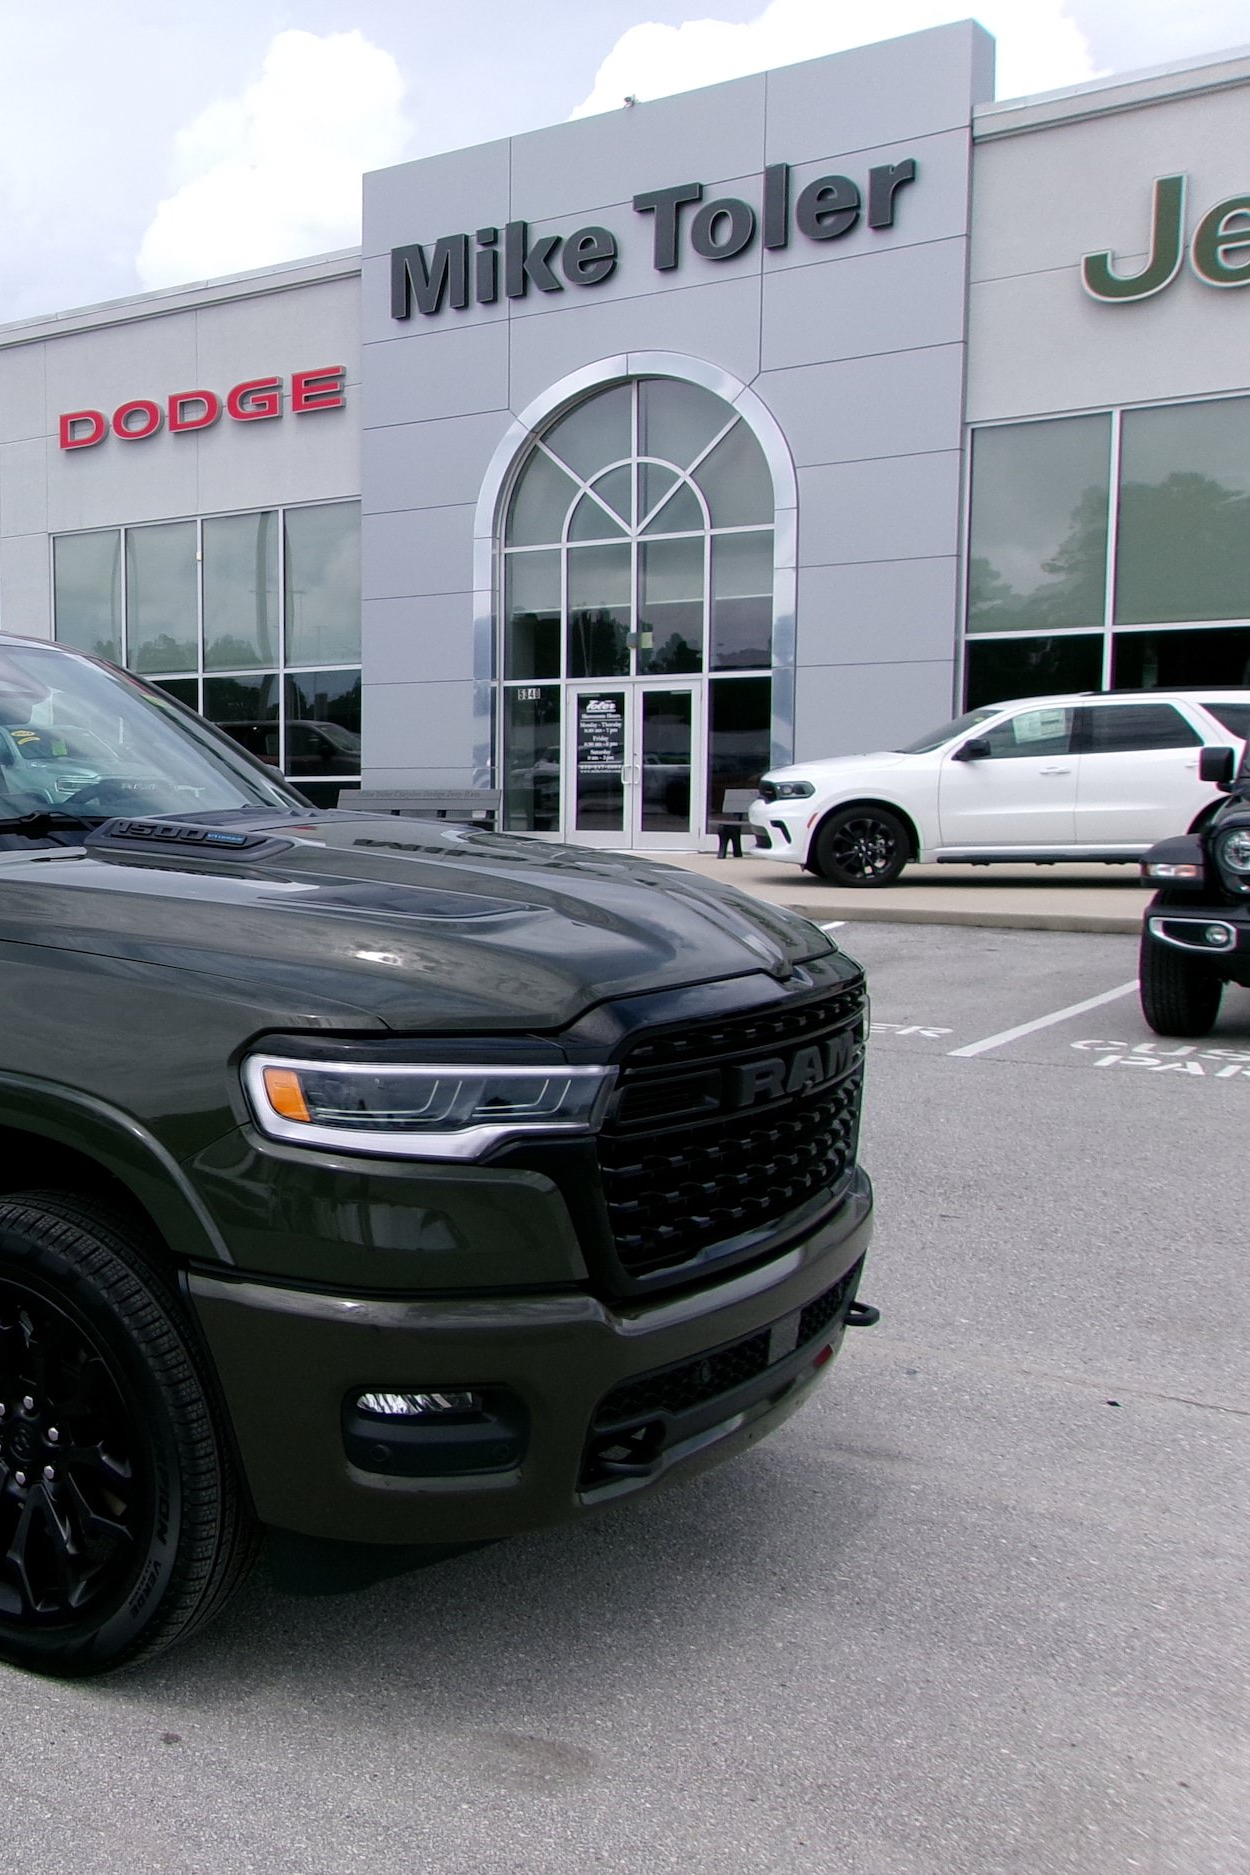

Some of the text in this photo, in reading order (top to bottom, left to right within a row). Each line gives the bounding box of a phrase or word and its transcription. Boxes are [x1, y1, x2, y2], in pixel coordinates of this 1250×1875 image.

[390, 158, 917, 320] Mike Toler
[1080, 170, 1250, 304] Je
[59, 364, 347, 451] DODGE
[116, 821, 207, 841] 1500
[735, 1029, 855, 1107] RAM
